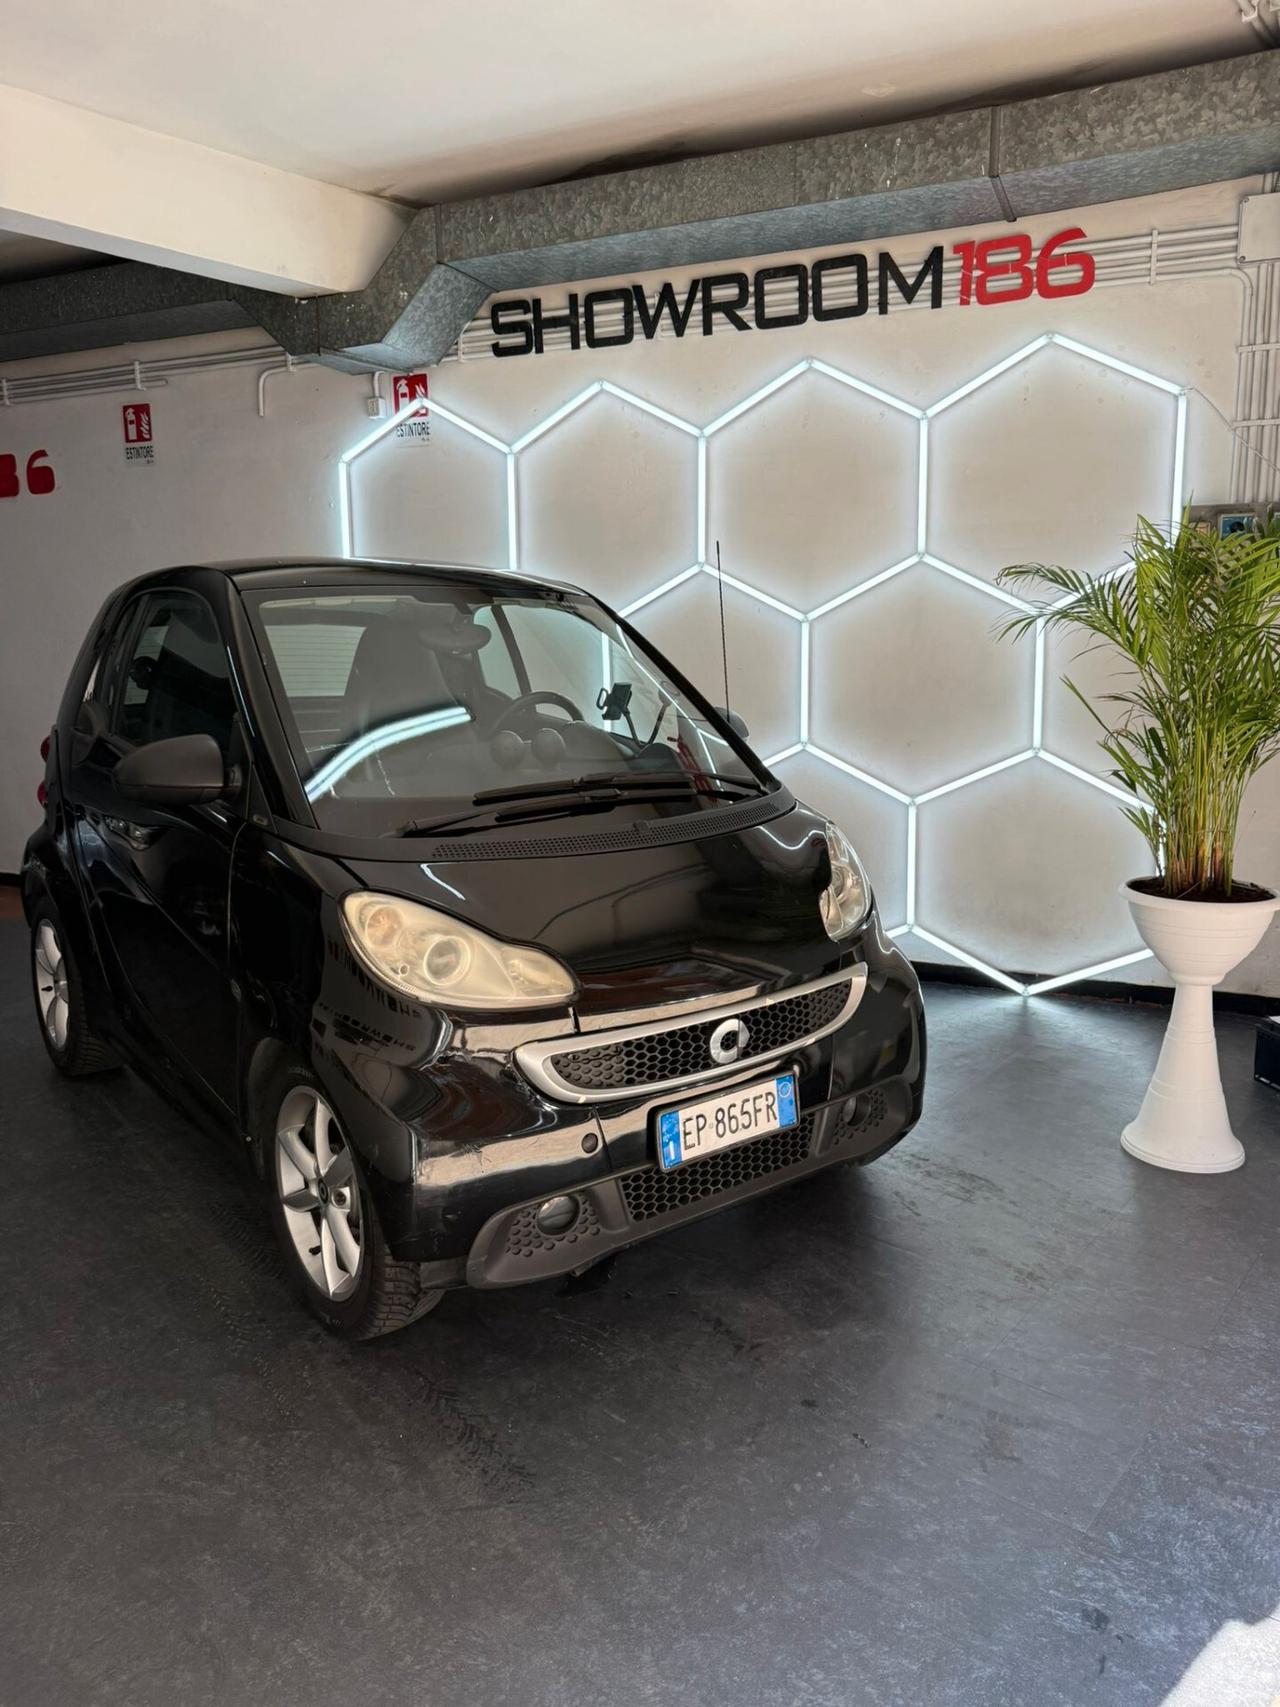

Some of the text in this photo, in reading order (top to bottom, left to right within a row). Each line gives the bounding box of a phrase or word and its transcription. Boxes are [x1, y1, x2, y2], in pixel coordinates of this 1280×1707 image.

[396, 422, 431, 438] ESTINTORE
[125, 445, 154, 461] ESTINTORE
[682, 1091, 778, 1151] EP 865FR
